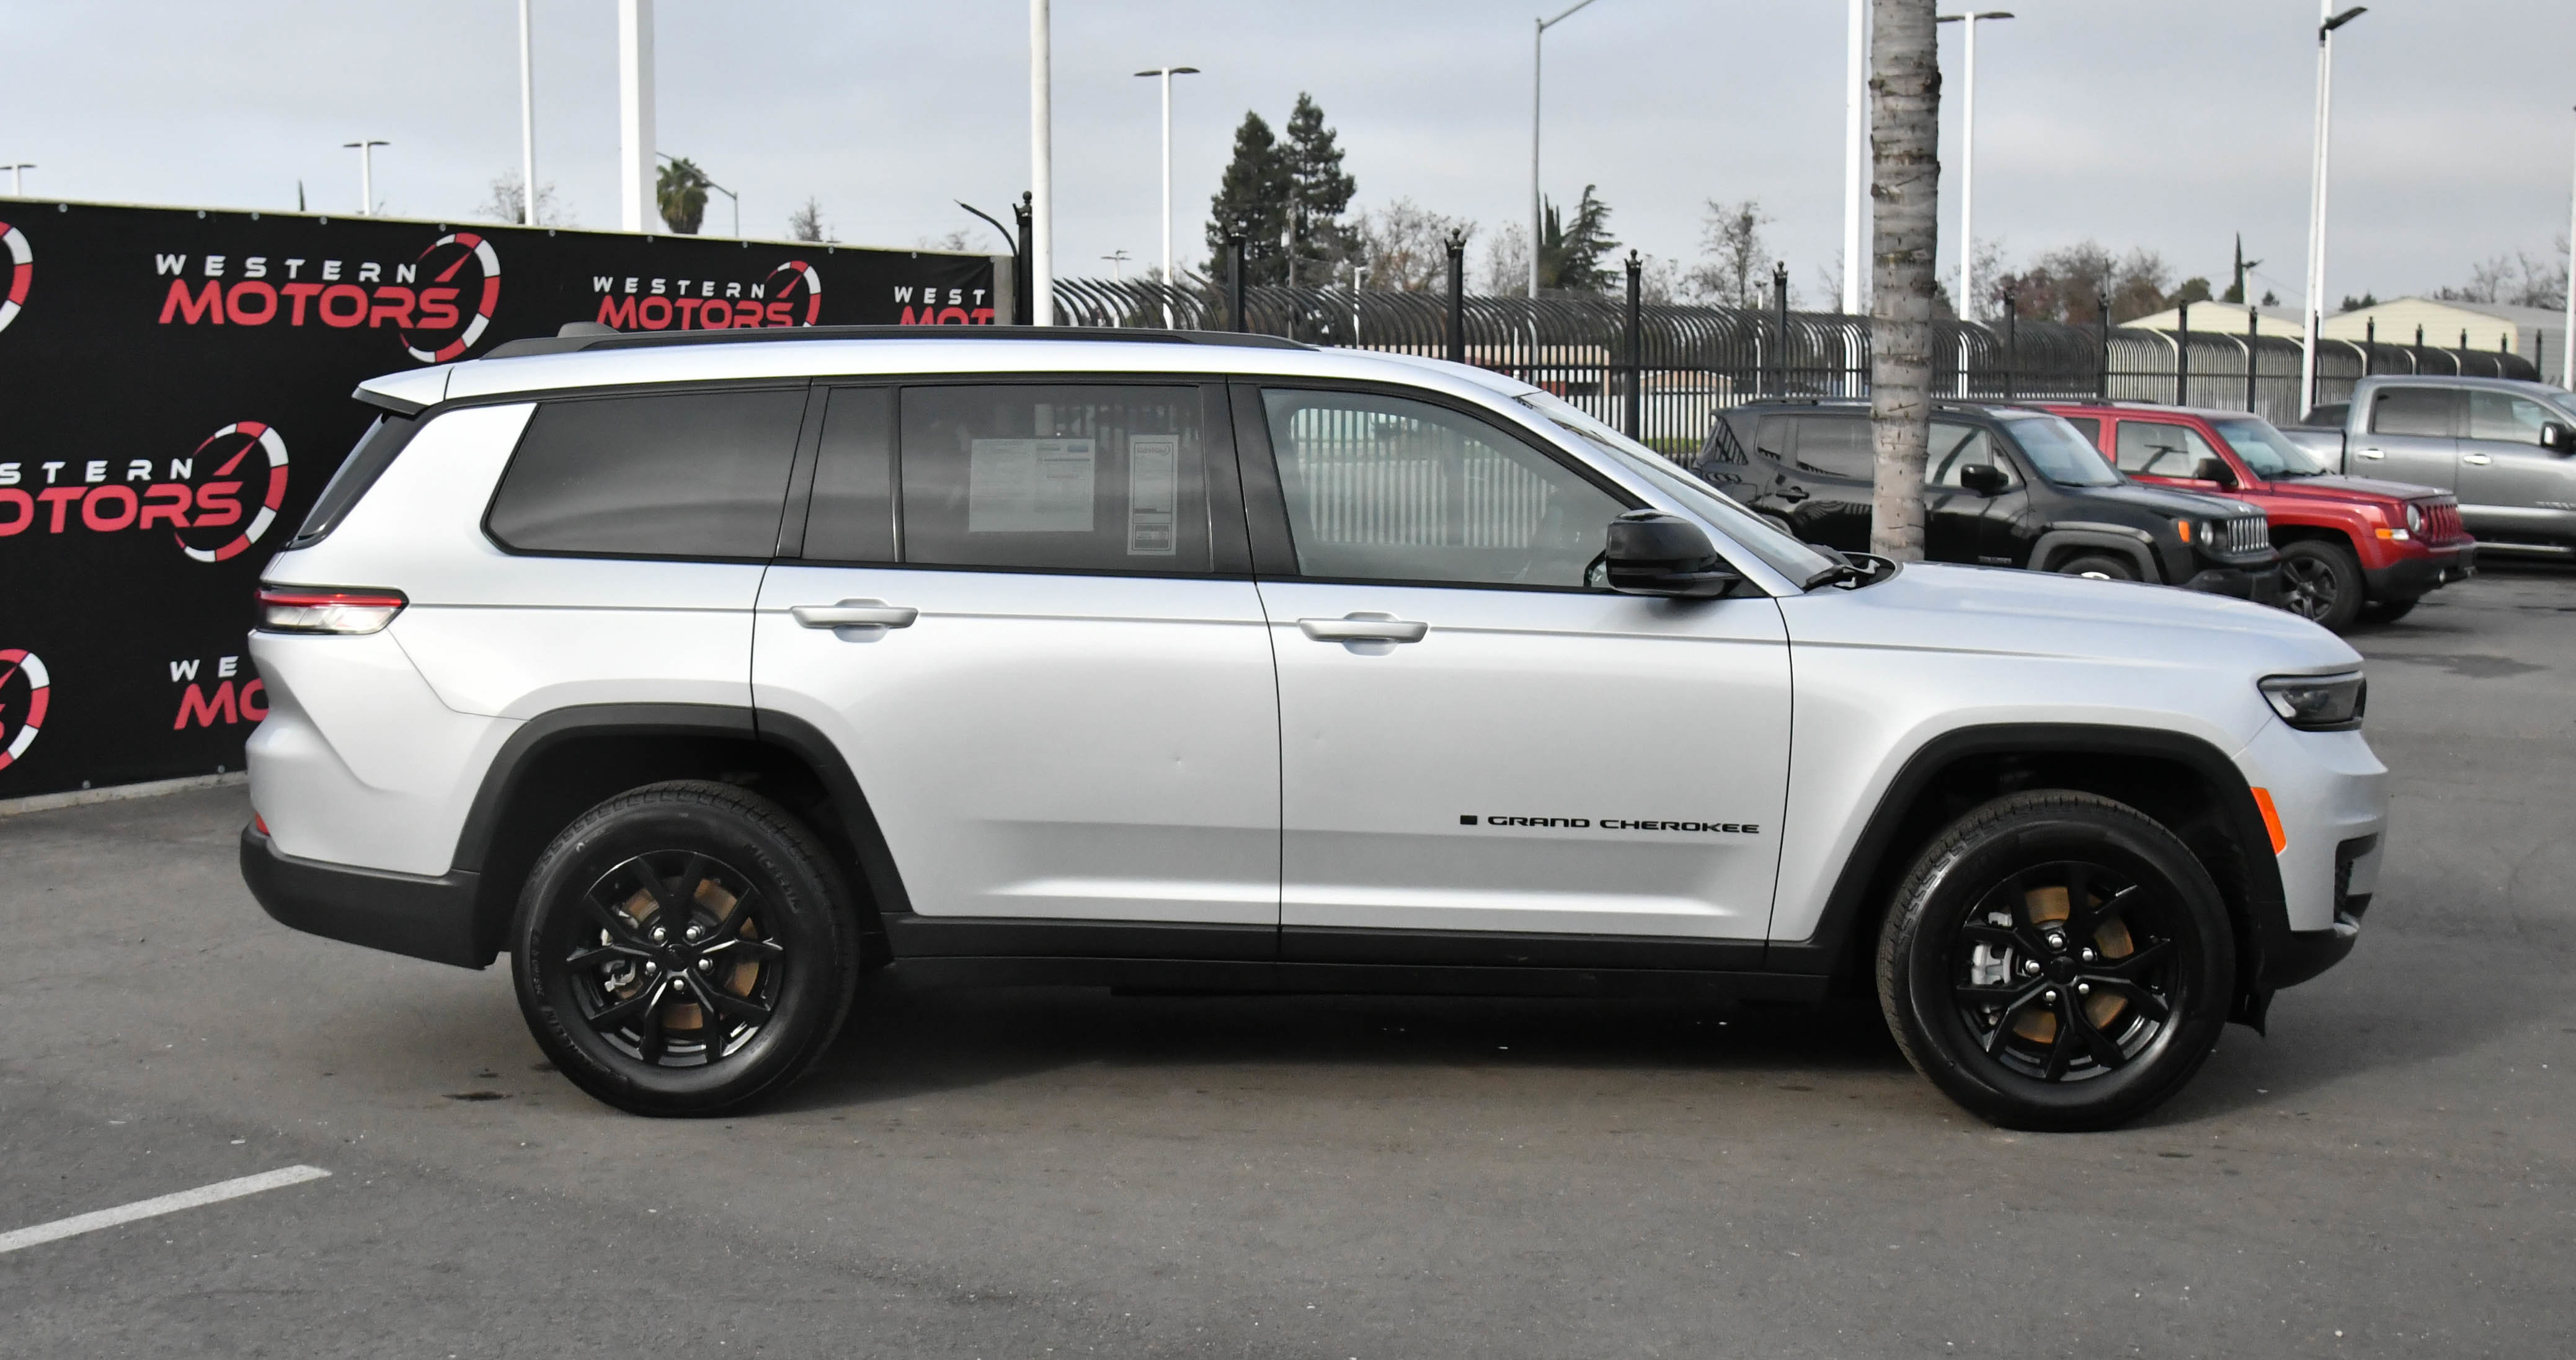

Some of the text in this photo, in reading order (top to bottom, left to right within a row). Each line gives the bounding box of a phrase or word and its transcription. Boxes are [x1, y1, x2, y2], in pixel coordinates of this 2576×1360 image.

[156, 254, 417, 283] WESTERN
[593, 276, 765, 299] WESTERN
[894, 286, 986, 305] WEST
[158, 278, 460, 329] MOTORS
[597, 295, 794, 331] MOTORS
[170, 656, 239, 682] WE
[1488, 816, 1760, 834] GRAND CHEROKEE
